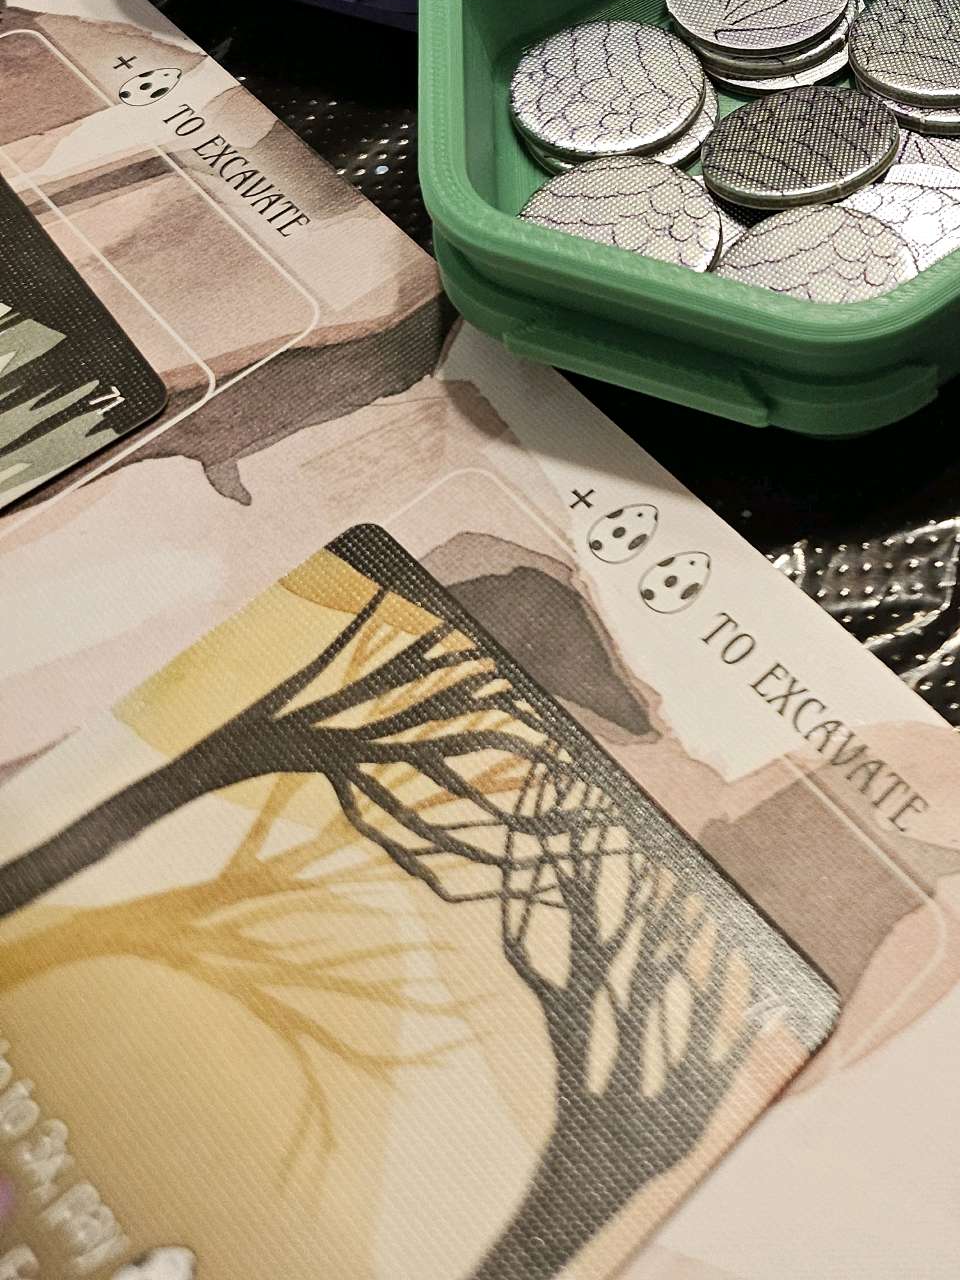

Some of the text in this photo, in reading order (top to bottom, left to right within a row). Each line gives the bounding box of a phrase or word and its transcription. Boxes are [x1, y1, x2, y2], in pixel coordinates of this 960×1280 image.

[161, 104, 206, 138] TO
[192, 134, 311, 238] EXCAVATE
[89, 385, 125, 414] 71
[701, 612, 755, 666] TO
[750, 663, 930, 833] EXCAVATE
